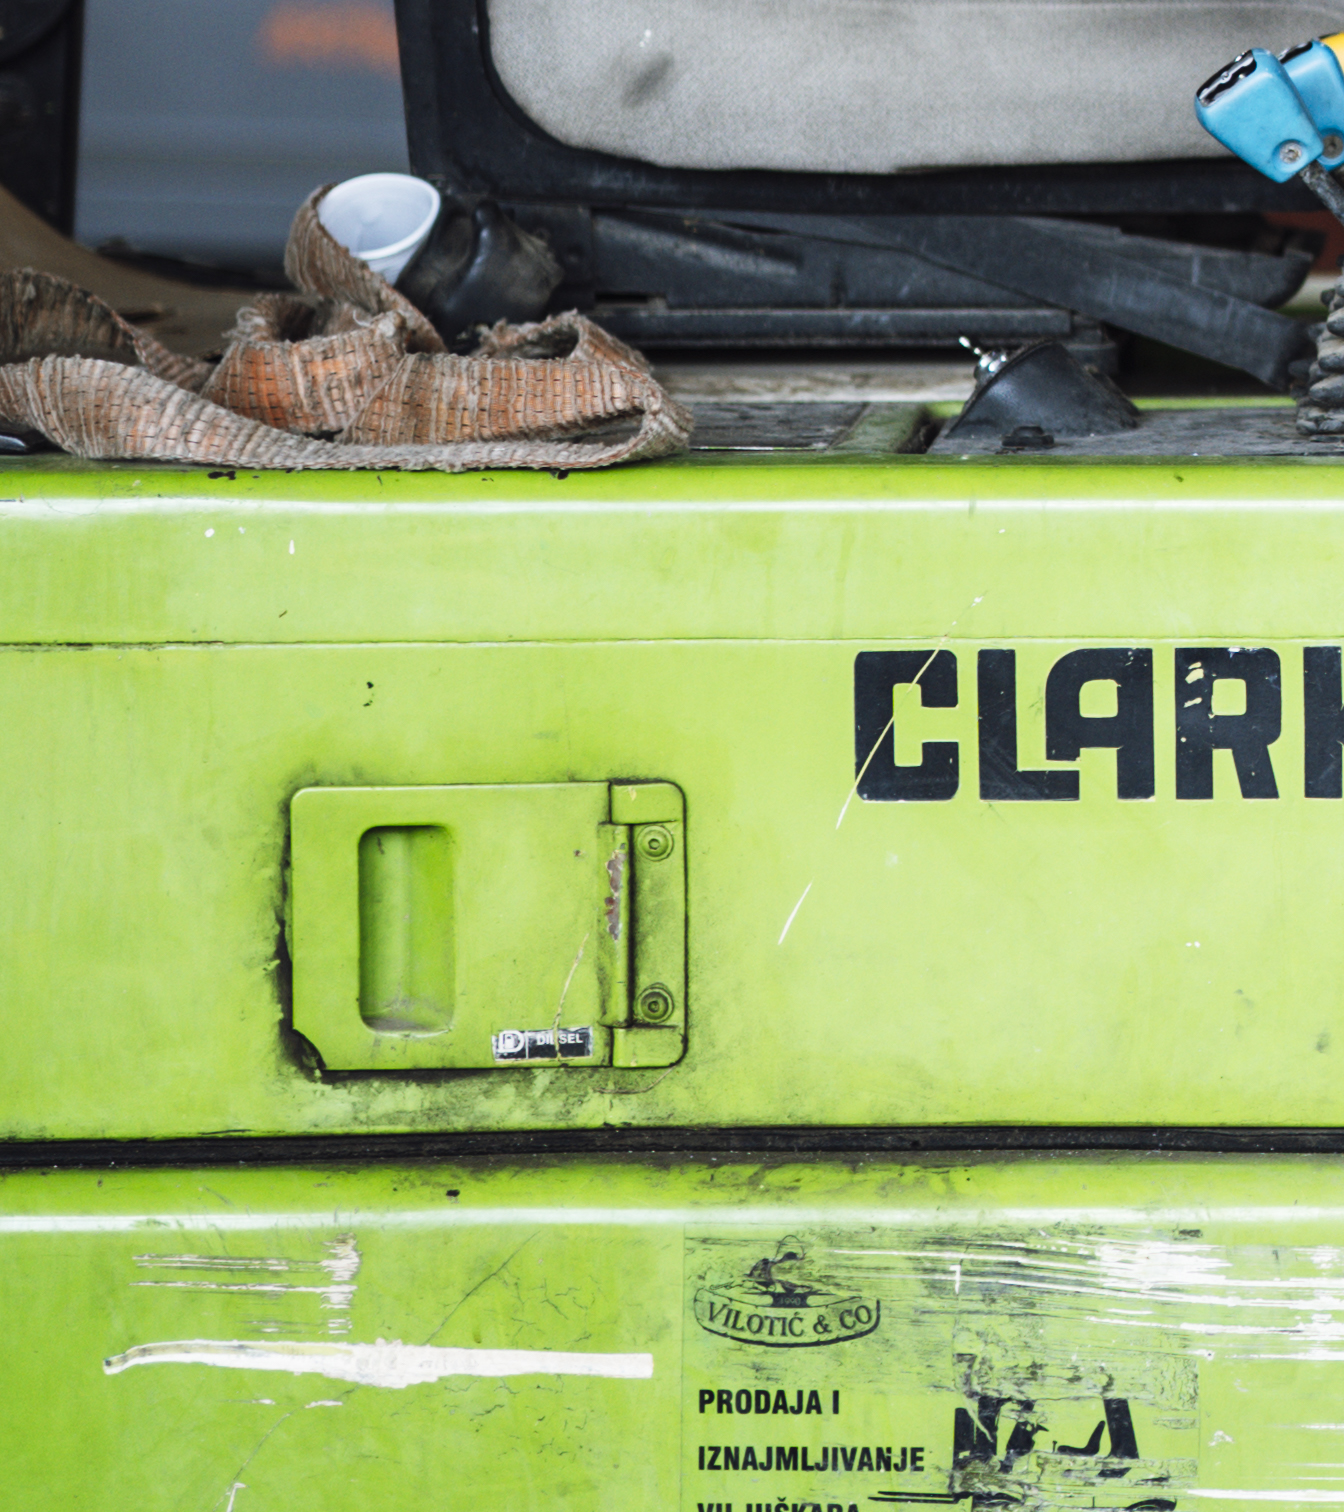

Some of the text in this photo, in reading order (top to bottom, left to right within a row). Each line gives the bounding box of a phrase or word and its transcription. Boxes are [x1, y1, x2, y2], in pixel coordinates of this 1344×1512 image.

[706, 1301, 872, 1337] VILOTIĆ & CO
[698, 1388, 840, 1415] PRODAJA I
[698, 1445, 925, 1473] IZNAJMLJIVANJE
